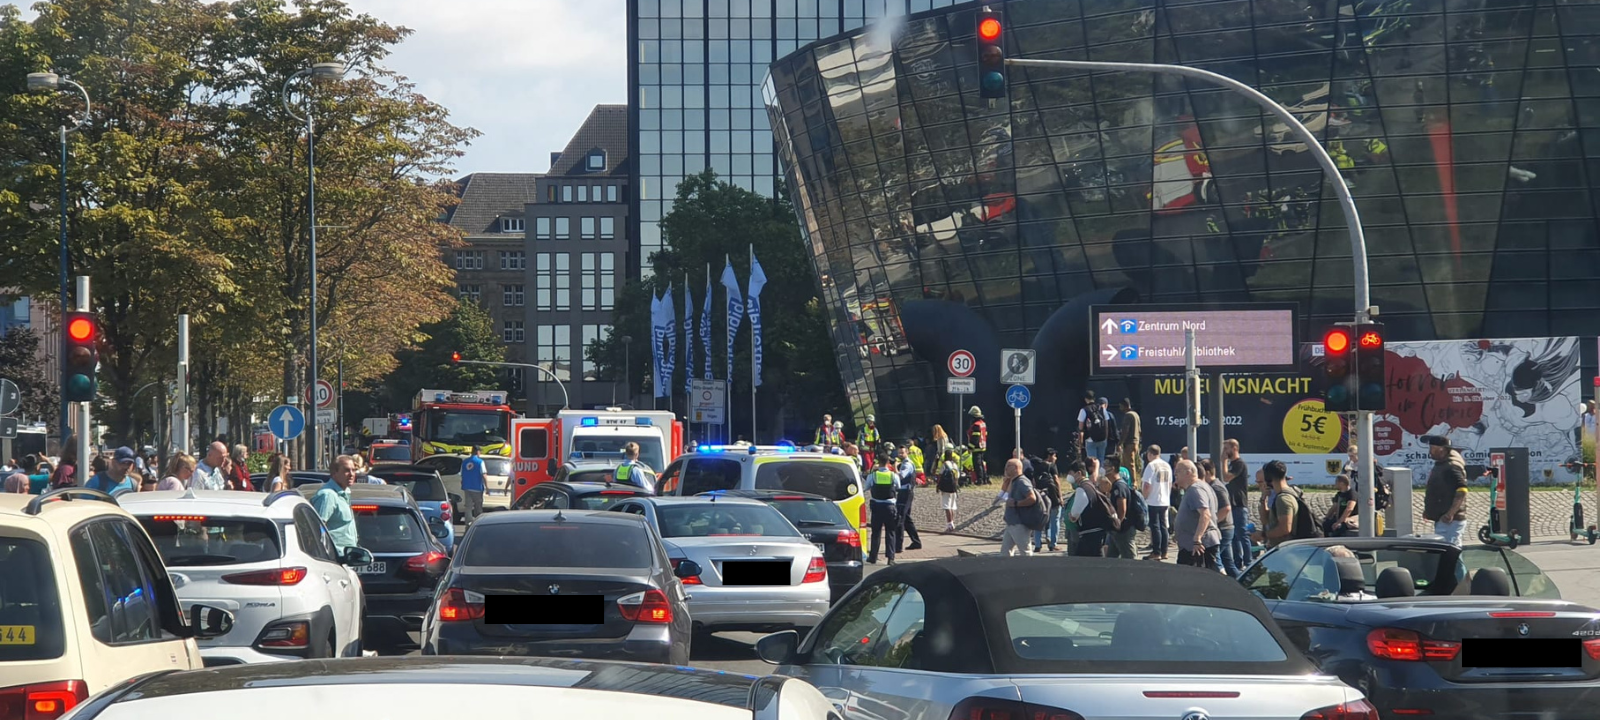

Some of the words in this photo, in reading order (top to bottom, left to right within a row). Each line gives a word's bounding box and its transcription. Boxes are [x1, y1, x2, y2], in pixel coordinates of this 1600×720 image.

[1138, 320, 1179, 331] Zentrum
[1182, 320, 1206, 331] Nord
[1138, 346, 1236, 357] Freistuhl/ibliothek
[954, 358, 970, 370] 30
[1154, 377, 1312, 395] MUEMSNACHT
[1297, 403, 1331, 414] Frühbuc
[1155, 416, 1167, 426] 17.
[1168, 416, 1210, 428] Septb
[1300, 413, 1328, 435] 5€
[1303, 442, 1330, 451] September
[1405, 451, 1432, 460] schau
[1464, 449, 1490, 458] comi
[366, 562, 385, 572] 688
